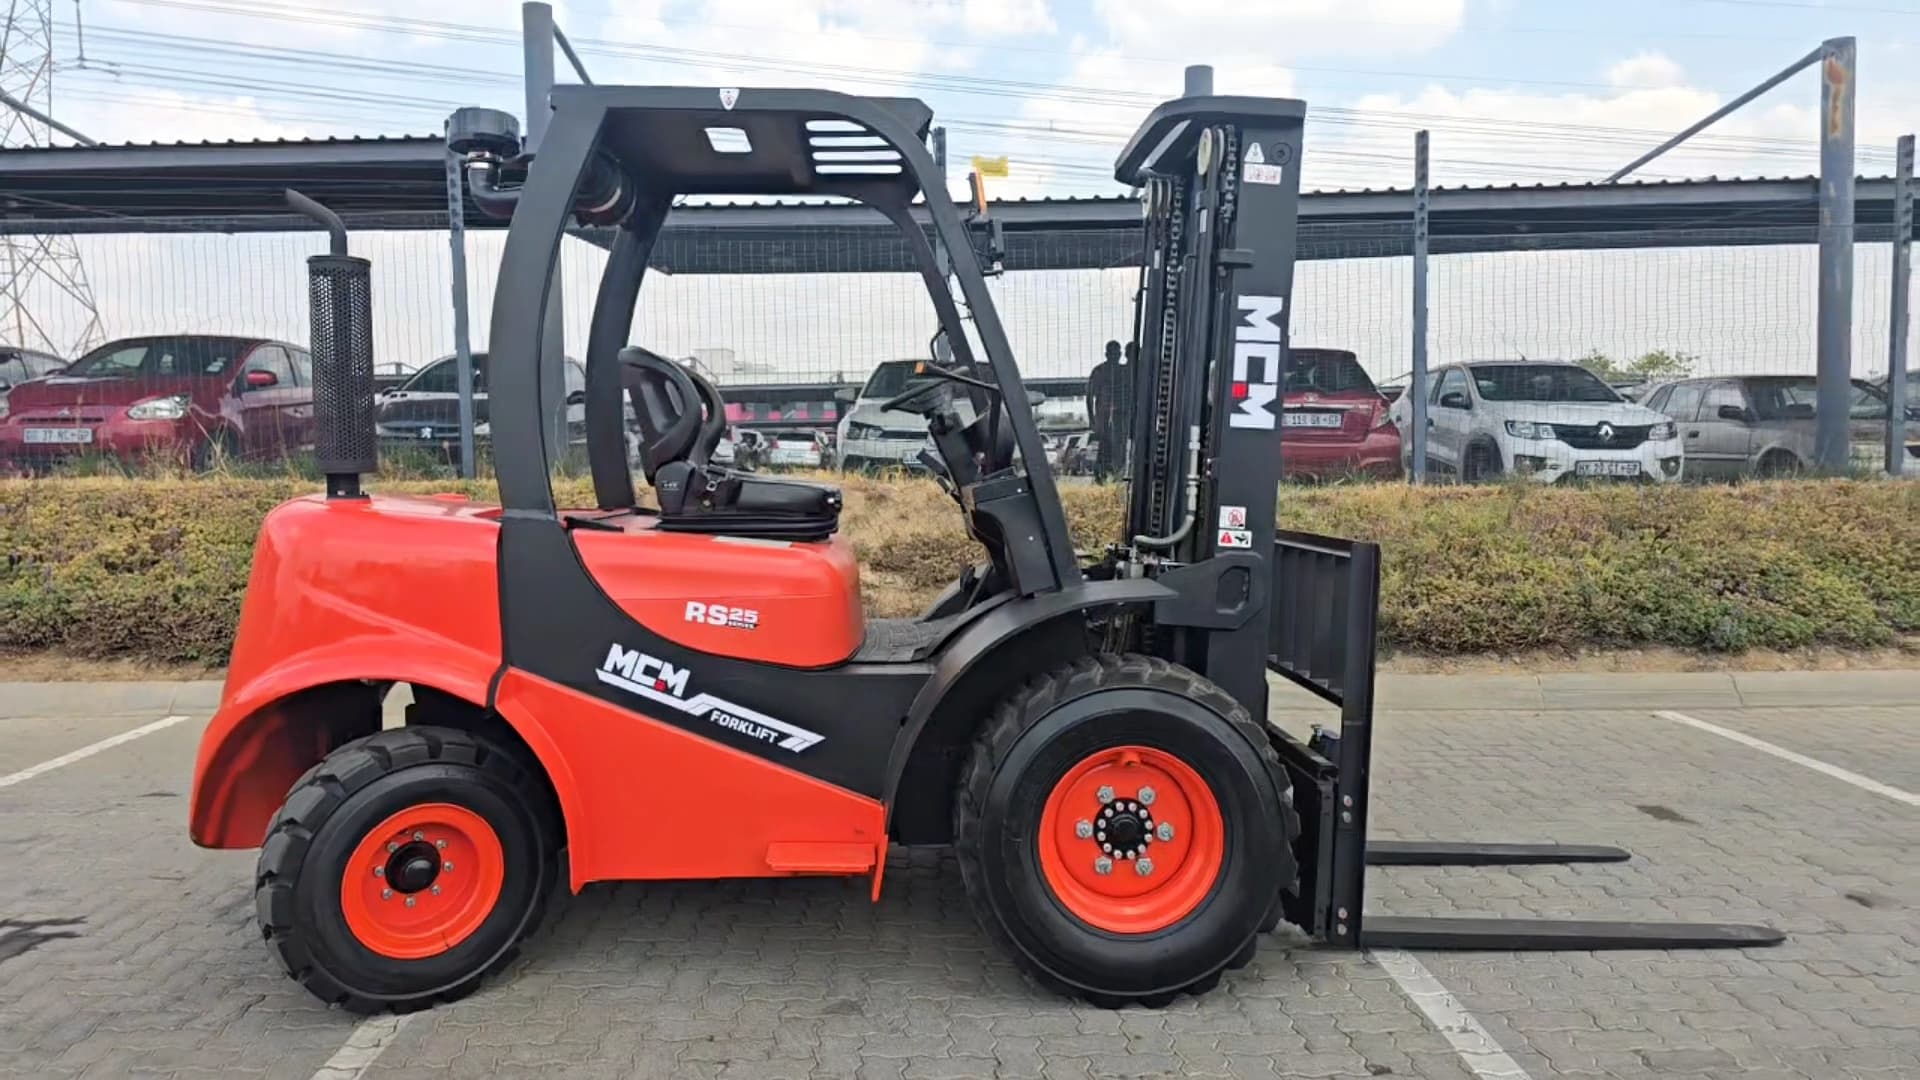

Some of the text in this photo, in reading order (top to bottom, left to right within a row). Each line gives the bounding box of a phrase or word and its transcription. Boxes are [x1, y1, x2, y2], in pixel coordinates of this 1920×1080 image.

[1230, 295, 1283, 430] MCM
[603, 642, 691, 698] MCM
[710, 710, 778, 744] FORKLIFT
